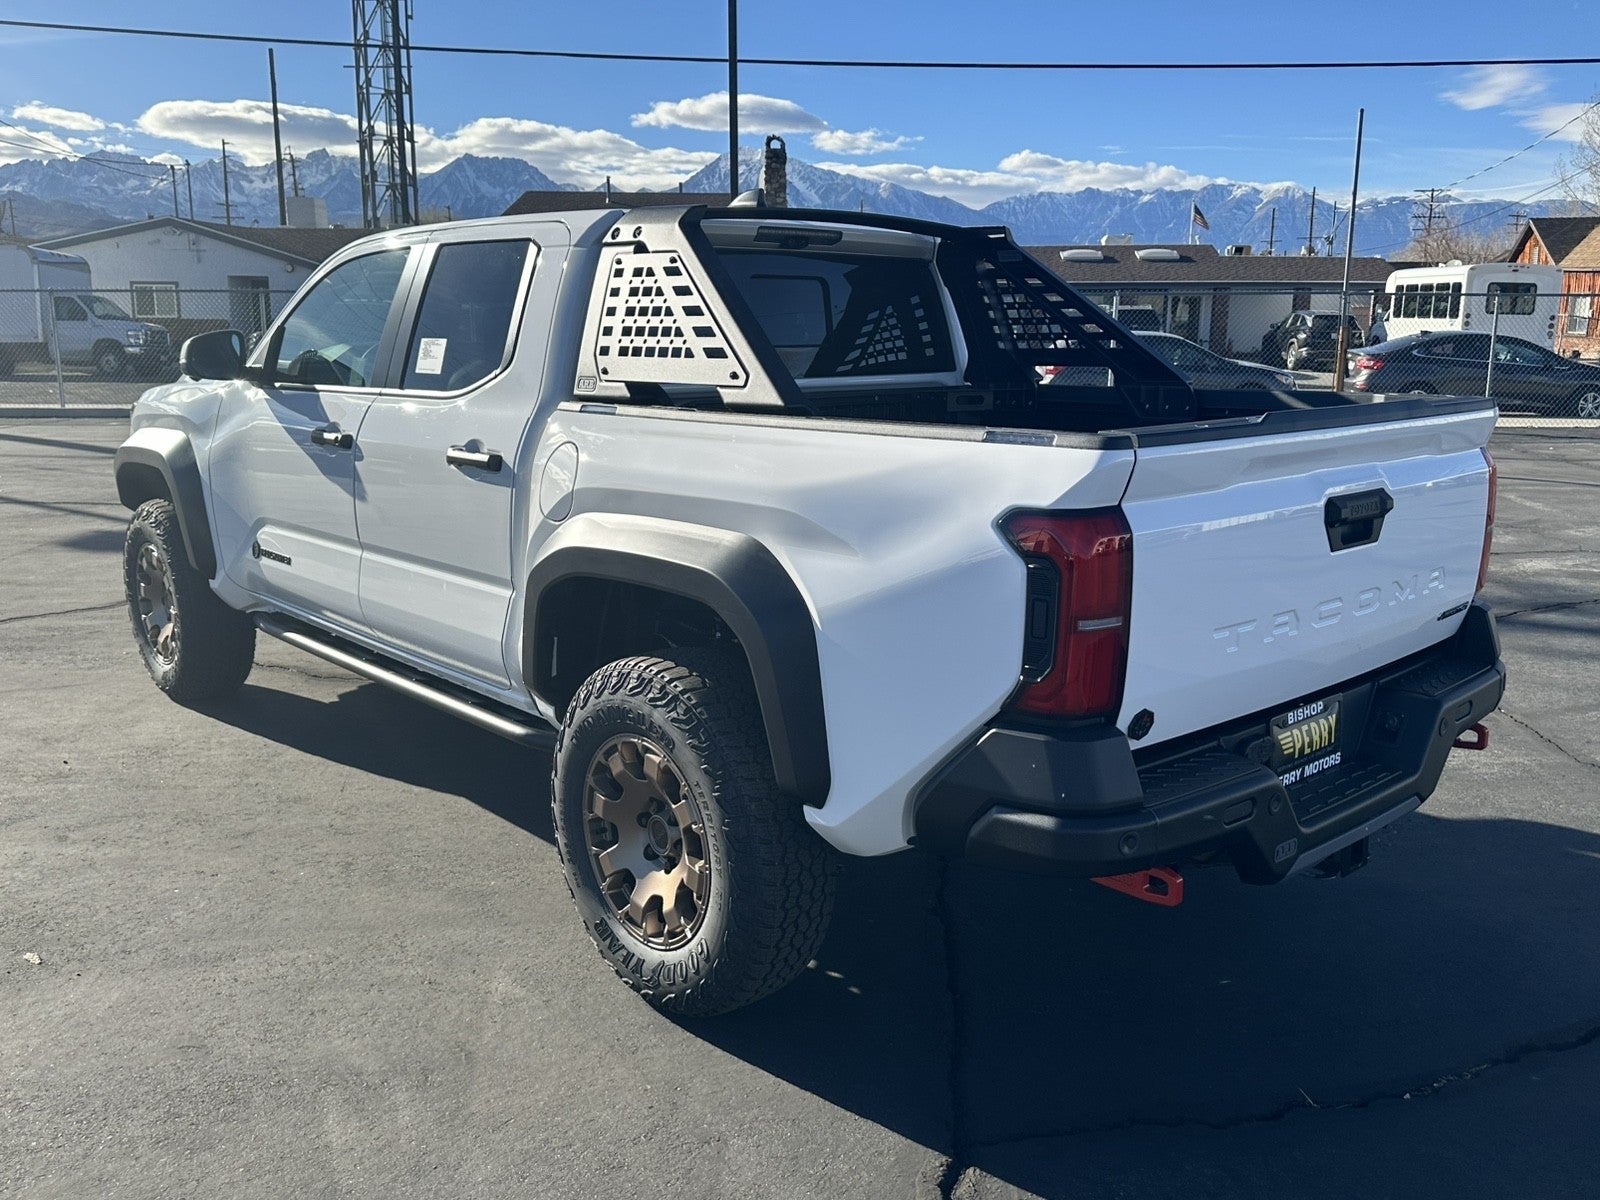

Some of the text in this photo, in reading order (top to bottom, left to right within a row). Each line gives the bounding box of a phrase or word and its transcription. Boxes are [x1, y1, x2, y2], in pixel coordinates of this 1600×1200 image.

[1350, 500, 1380, 517] TOYOTA
[1212, 565, 1446, 653] TACOMA
[1287, 701, 1324, 725] BISHOP
[1292, 713, 1337, 759] PERRY
[1303, 751, 1342, 778] MOTORS
[694, 780, 722, 879] TERRITORY
[594, 916, 711, 989] GOODYEAR
